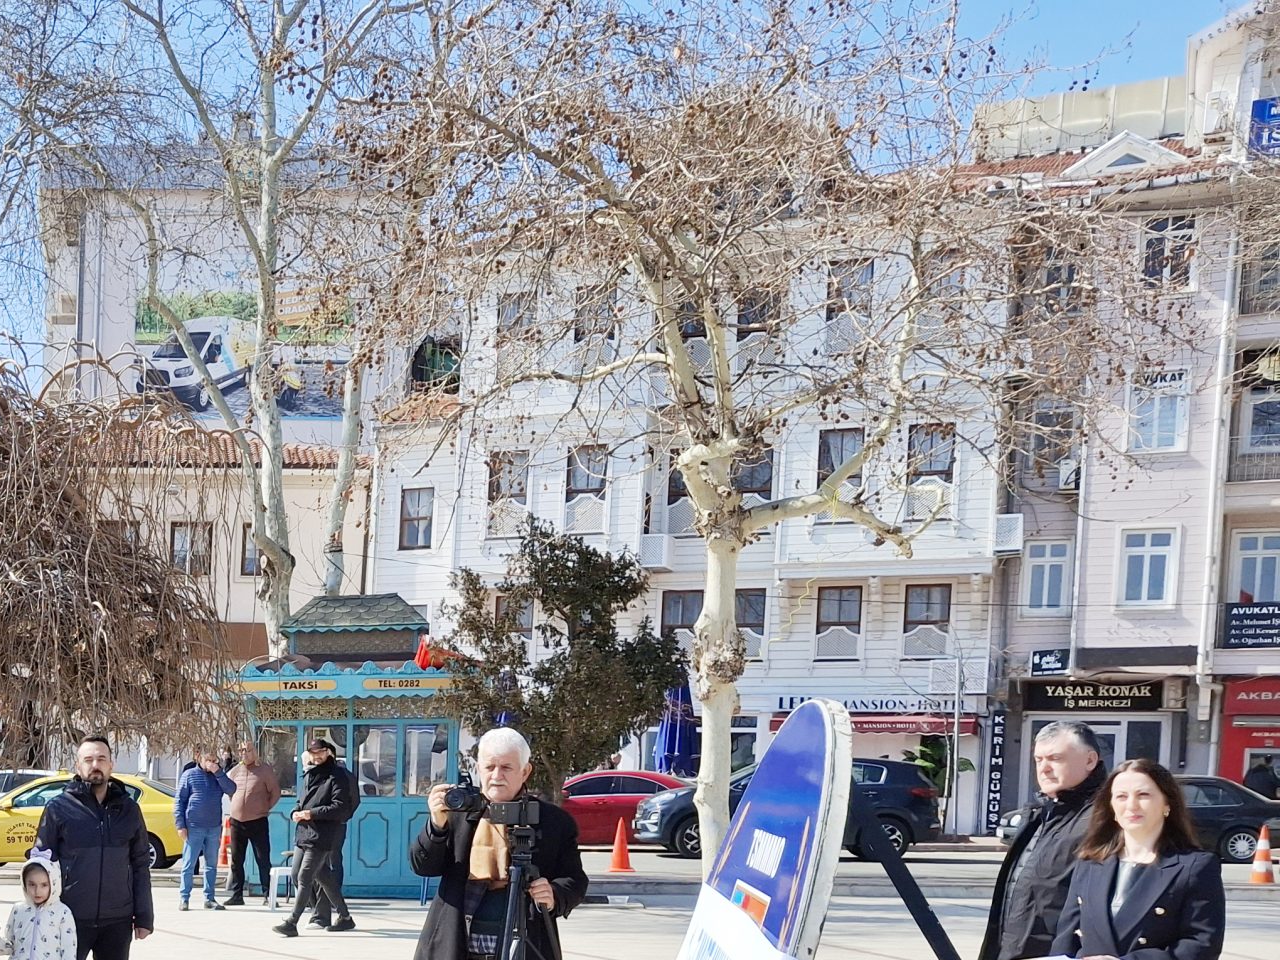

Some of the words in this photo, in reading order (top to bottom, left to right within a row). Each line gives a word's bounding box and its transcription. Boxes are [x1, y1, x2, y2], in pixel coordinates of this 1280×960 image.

[1141, 372, 1185, 385] VUKAT
[378, 680, 396, 688] TEL:
[398, 679, 421, 688] 0282
[1046, 685, 1094, 699] YAŞAR
[1098, 685, 1152, 697] KONAK
[1064, 698, 1075, 708] İŞ
[1078, 698, 1131, 708] MERKEZİ
[863, 721, 892, 730] MANSION
[896, 721, 917, 730] HOTEL
[991, 715, 1005, 766] KERİM
[989, 771, 1002, 823] GÜMÜŞ
[6, 836, 16, 844] 59
